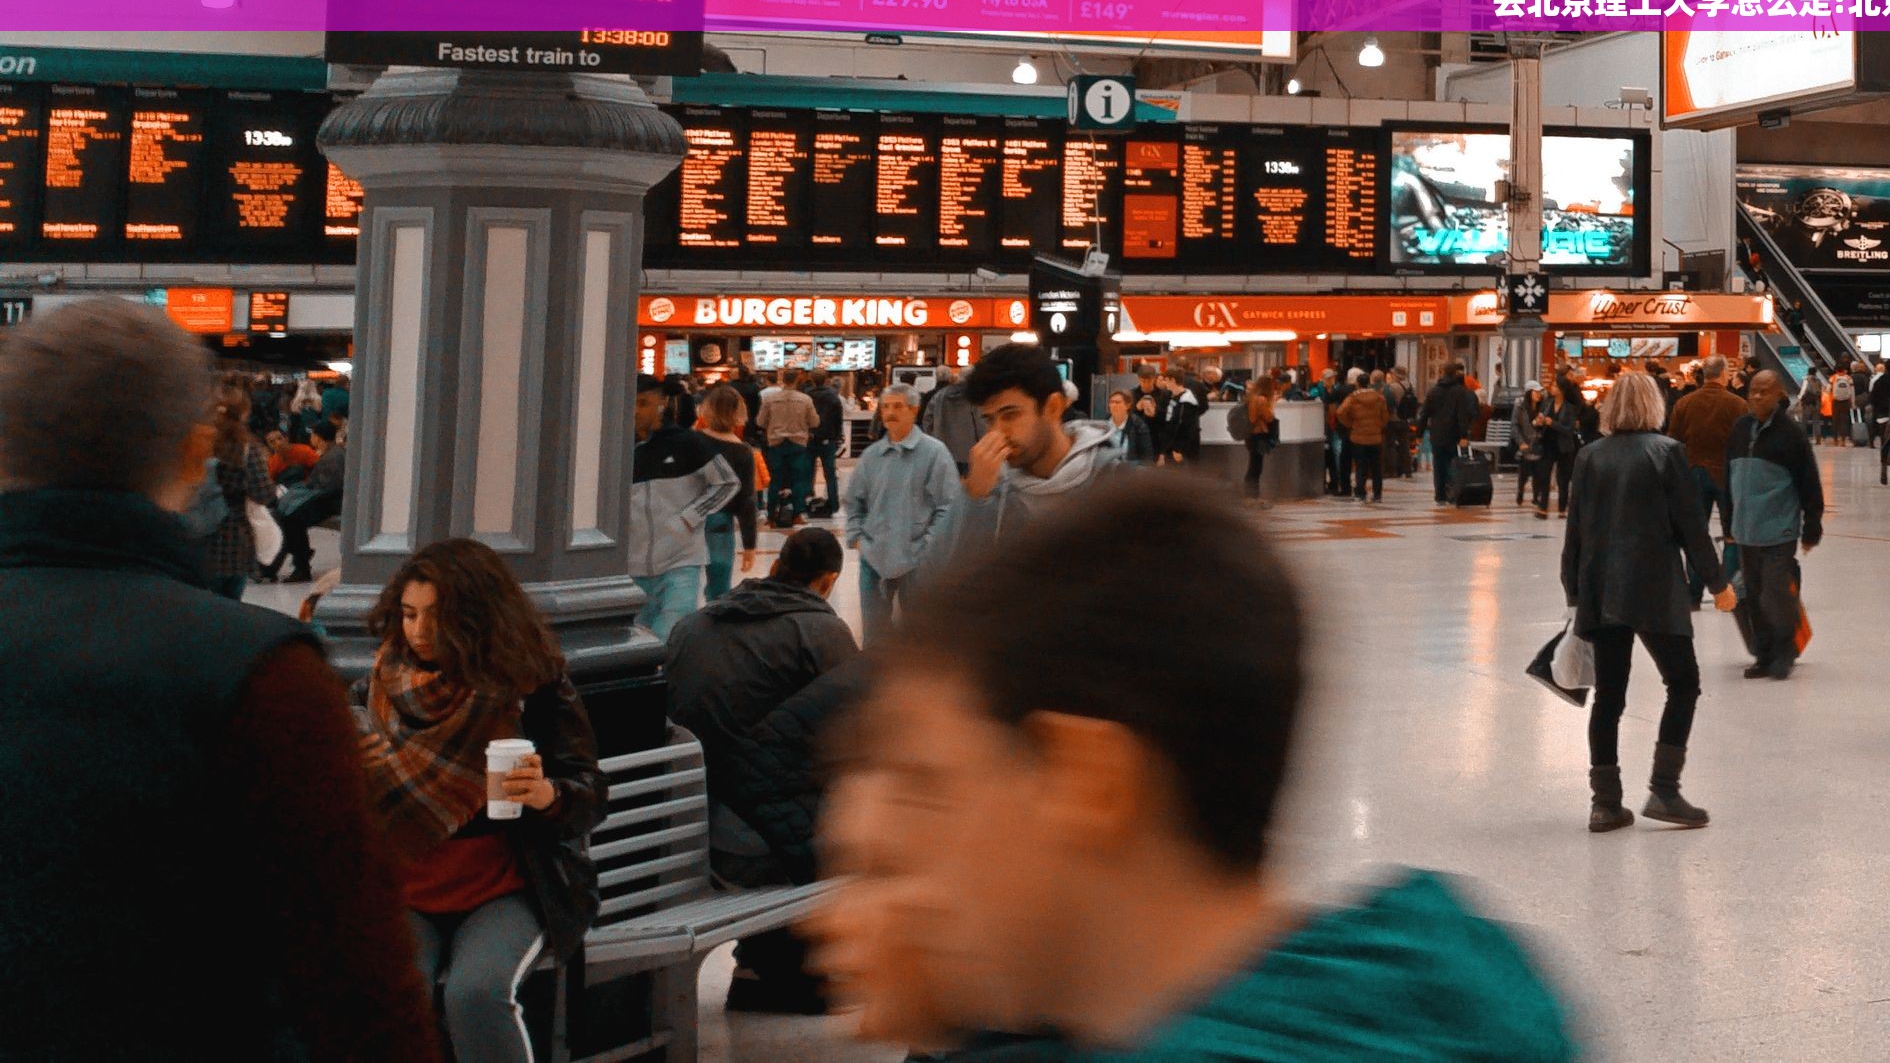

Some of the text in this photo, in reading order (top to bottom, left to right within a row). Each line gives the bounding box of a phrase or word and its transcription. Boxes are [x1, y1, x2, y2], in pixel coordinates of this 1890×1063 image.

[438, 42, 600, 66] Fastest train to
[1836, 250, 1889, 260] BREITLING
[3, 302, 24, 324] 11
[694, 298, 928, 326] BURGER KING
[1193, 301, 1238, 328] GX
[1287, 310, 1326, 319] EXPRESS
[1592, 297, 1694, 320] Upper Crust
